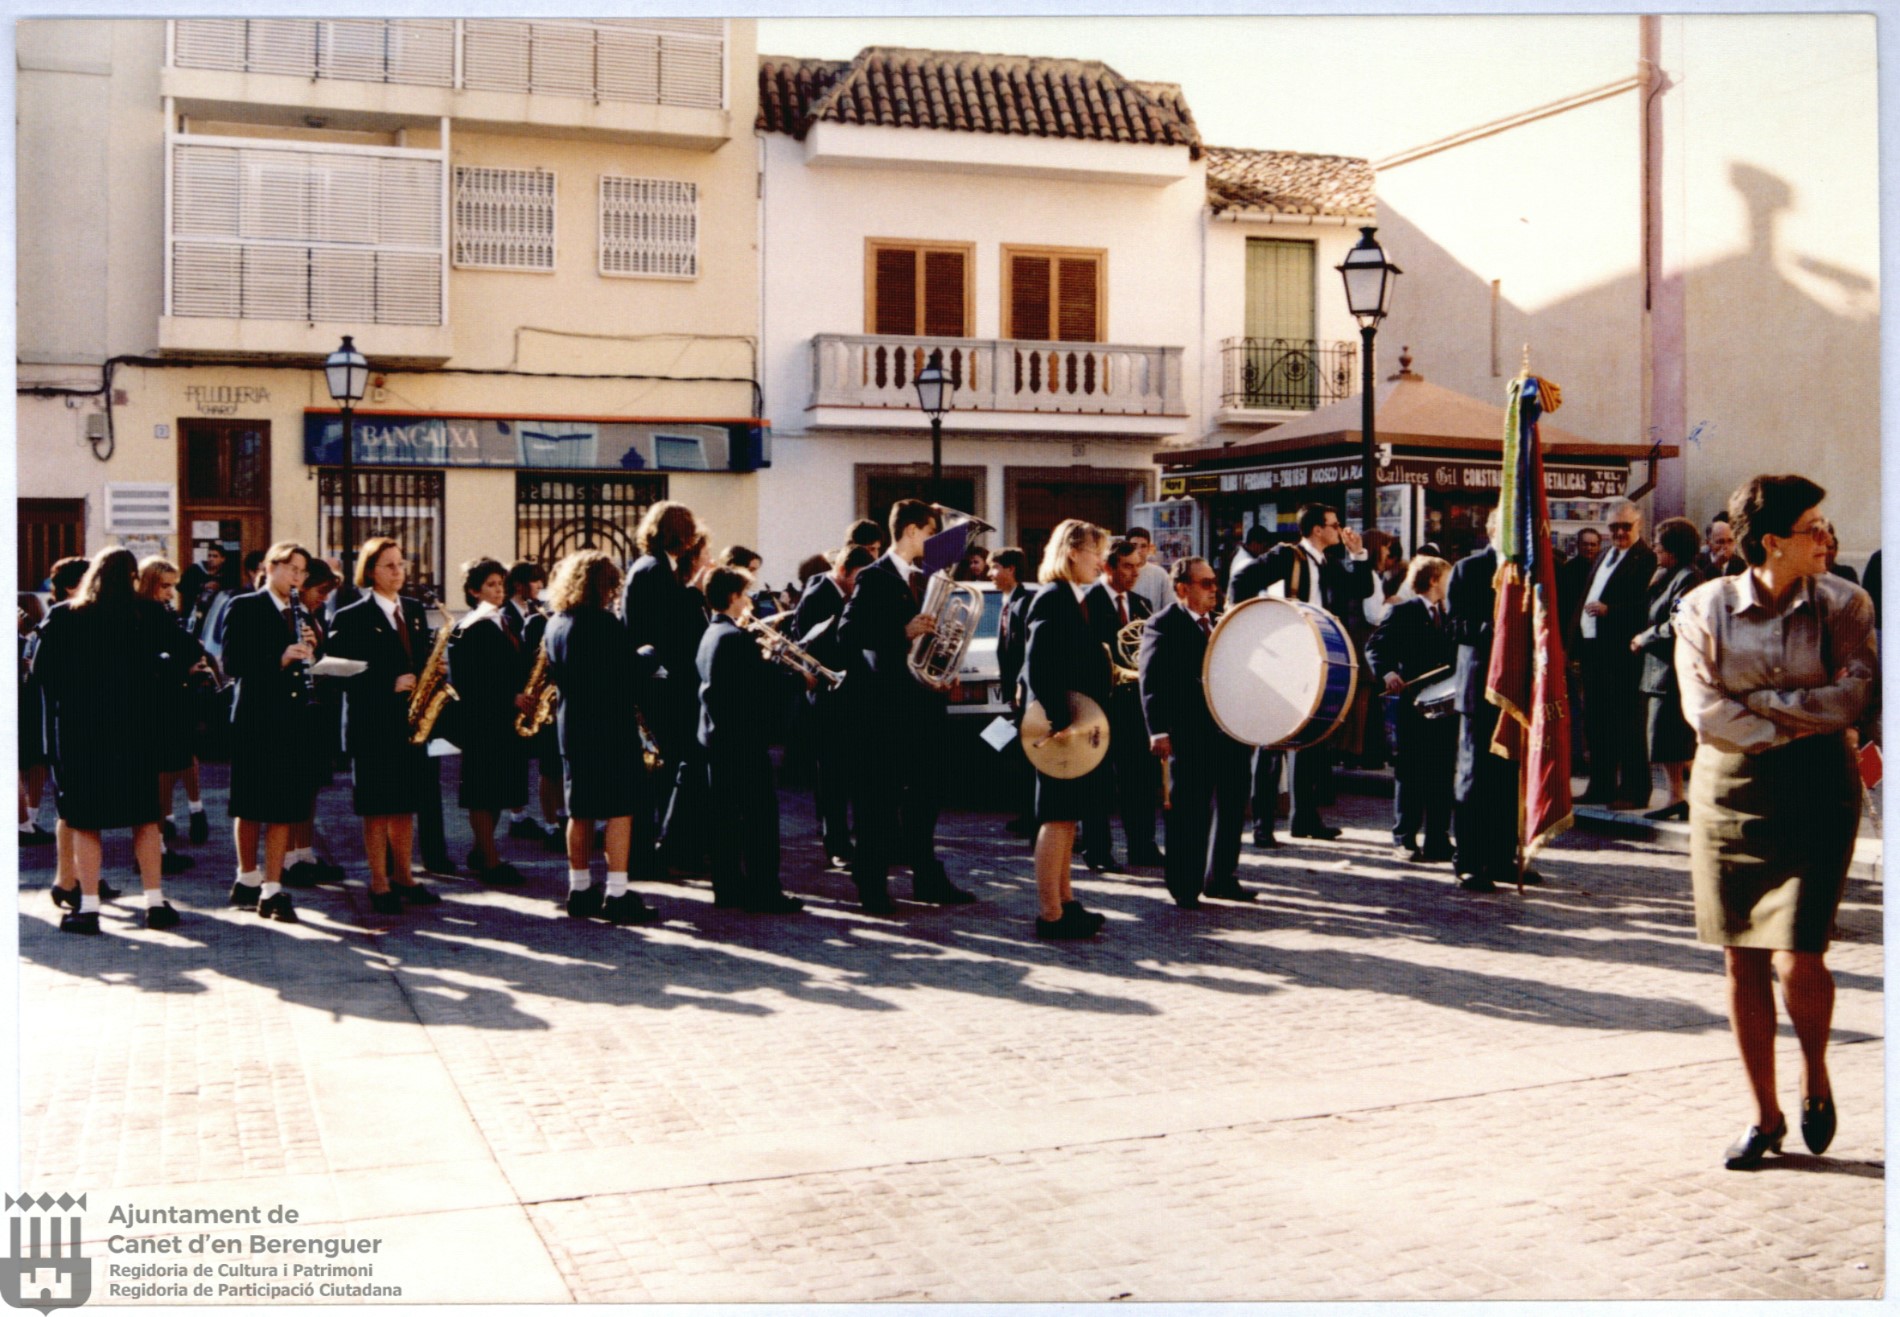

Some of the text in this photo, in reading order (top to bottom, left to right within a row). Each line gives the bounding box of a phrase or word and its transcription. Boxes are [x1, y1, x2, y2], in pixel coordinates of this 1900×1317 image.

[361, 425, 479, 448] BANCAIXA
[1311, 465, 1363, 483] KIOSCO LA PLA
[1435, 466, 1457, 485] Gil
